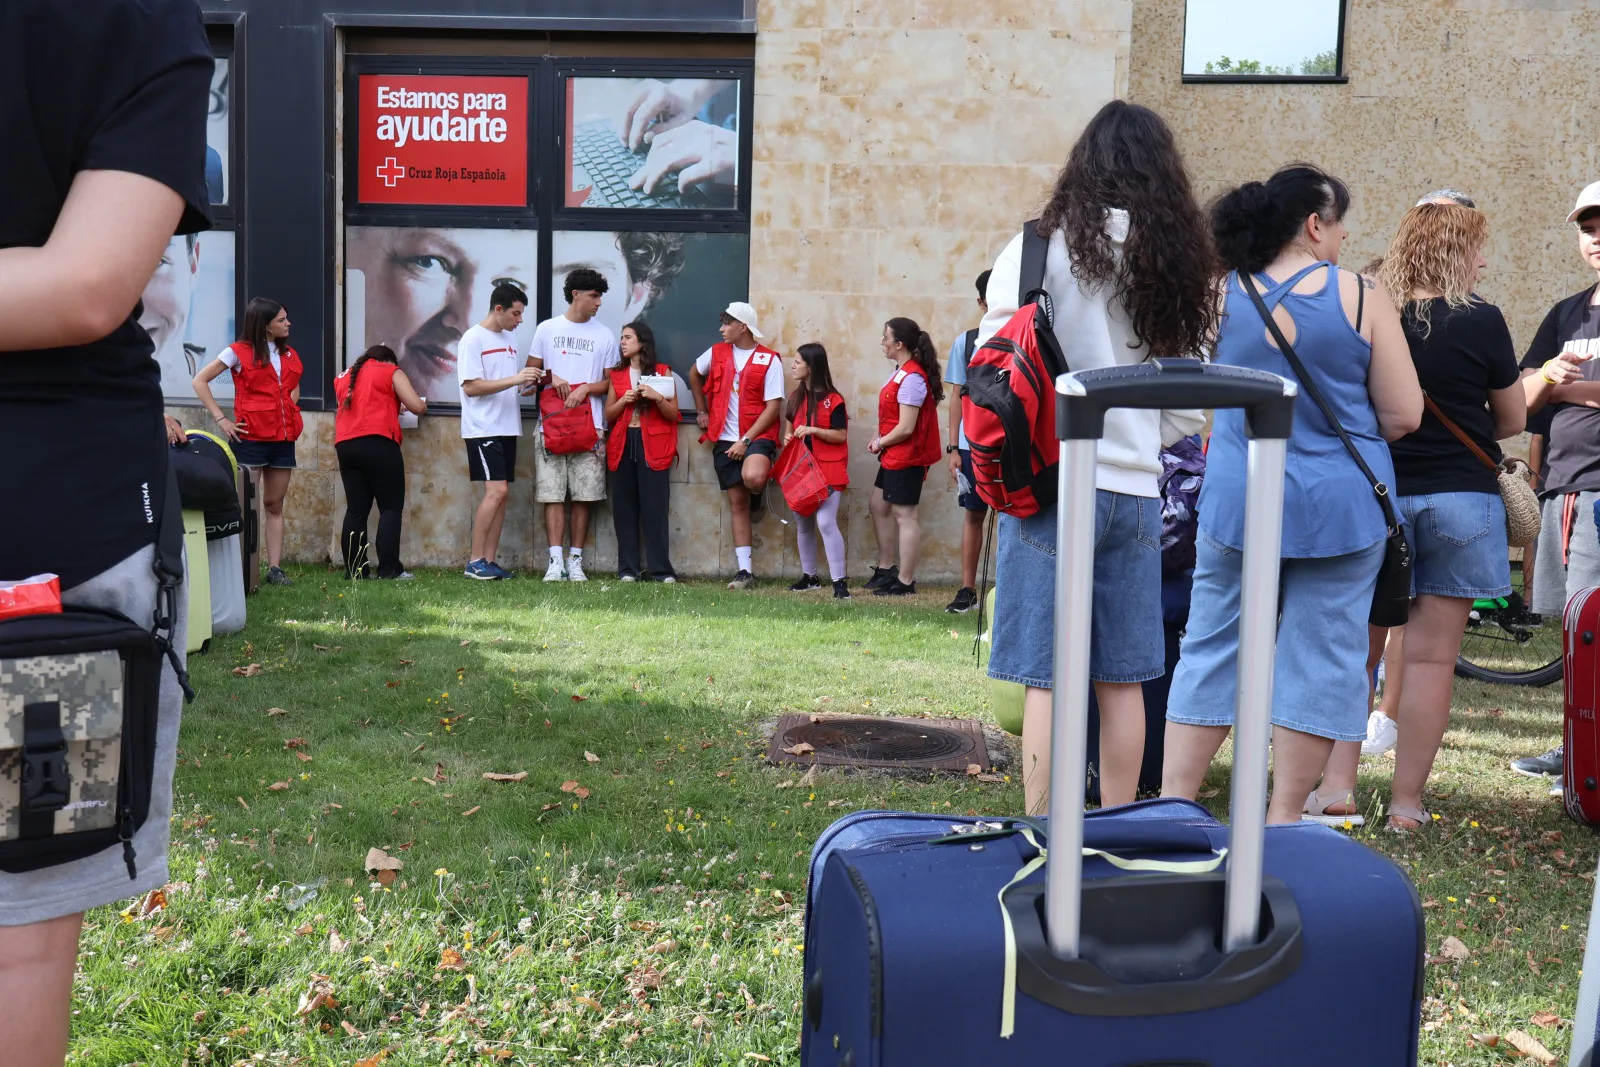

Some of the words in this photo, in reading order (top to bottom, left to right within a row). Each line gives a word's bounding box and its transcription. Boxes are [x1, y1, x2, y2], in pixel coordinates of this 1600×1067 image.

[377, 86, 459, 110] Estamos
[463, 92, 507, 114] para
[376, 109, 508, 148] ayudarte
[408, 166, 432, 179] Cruz
[435, 167, 458, 182] Roja
[461, 168, 506, 183] Española
[553, 336, 566, 348] SER
[567, 337, 595, 352] MEJORES
[141, 482, 153, 523] KUIKMA
